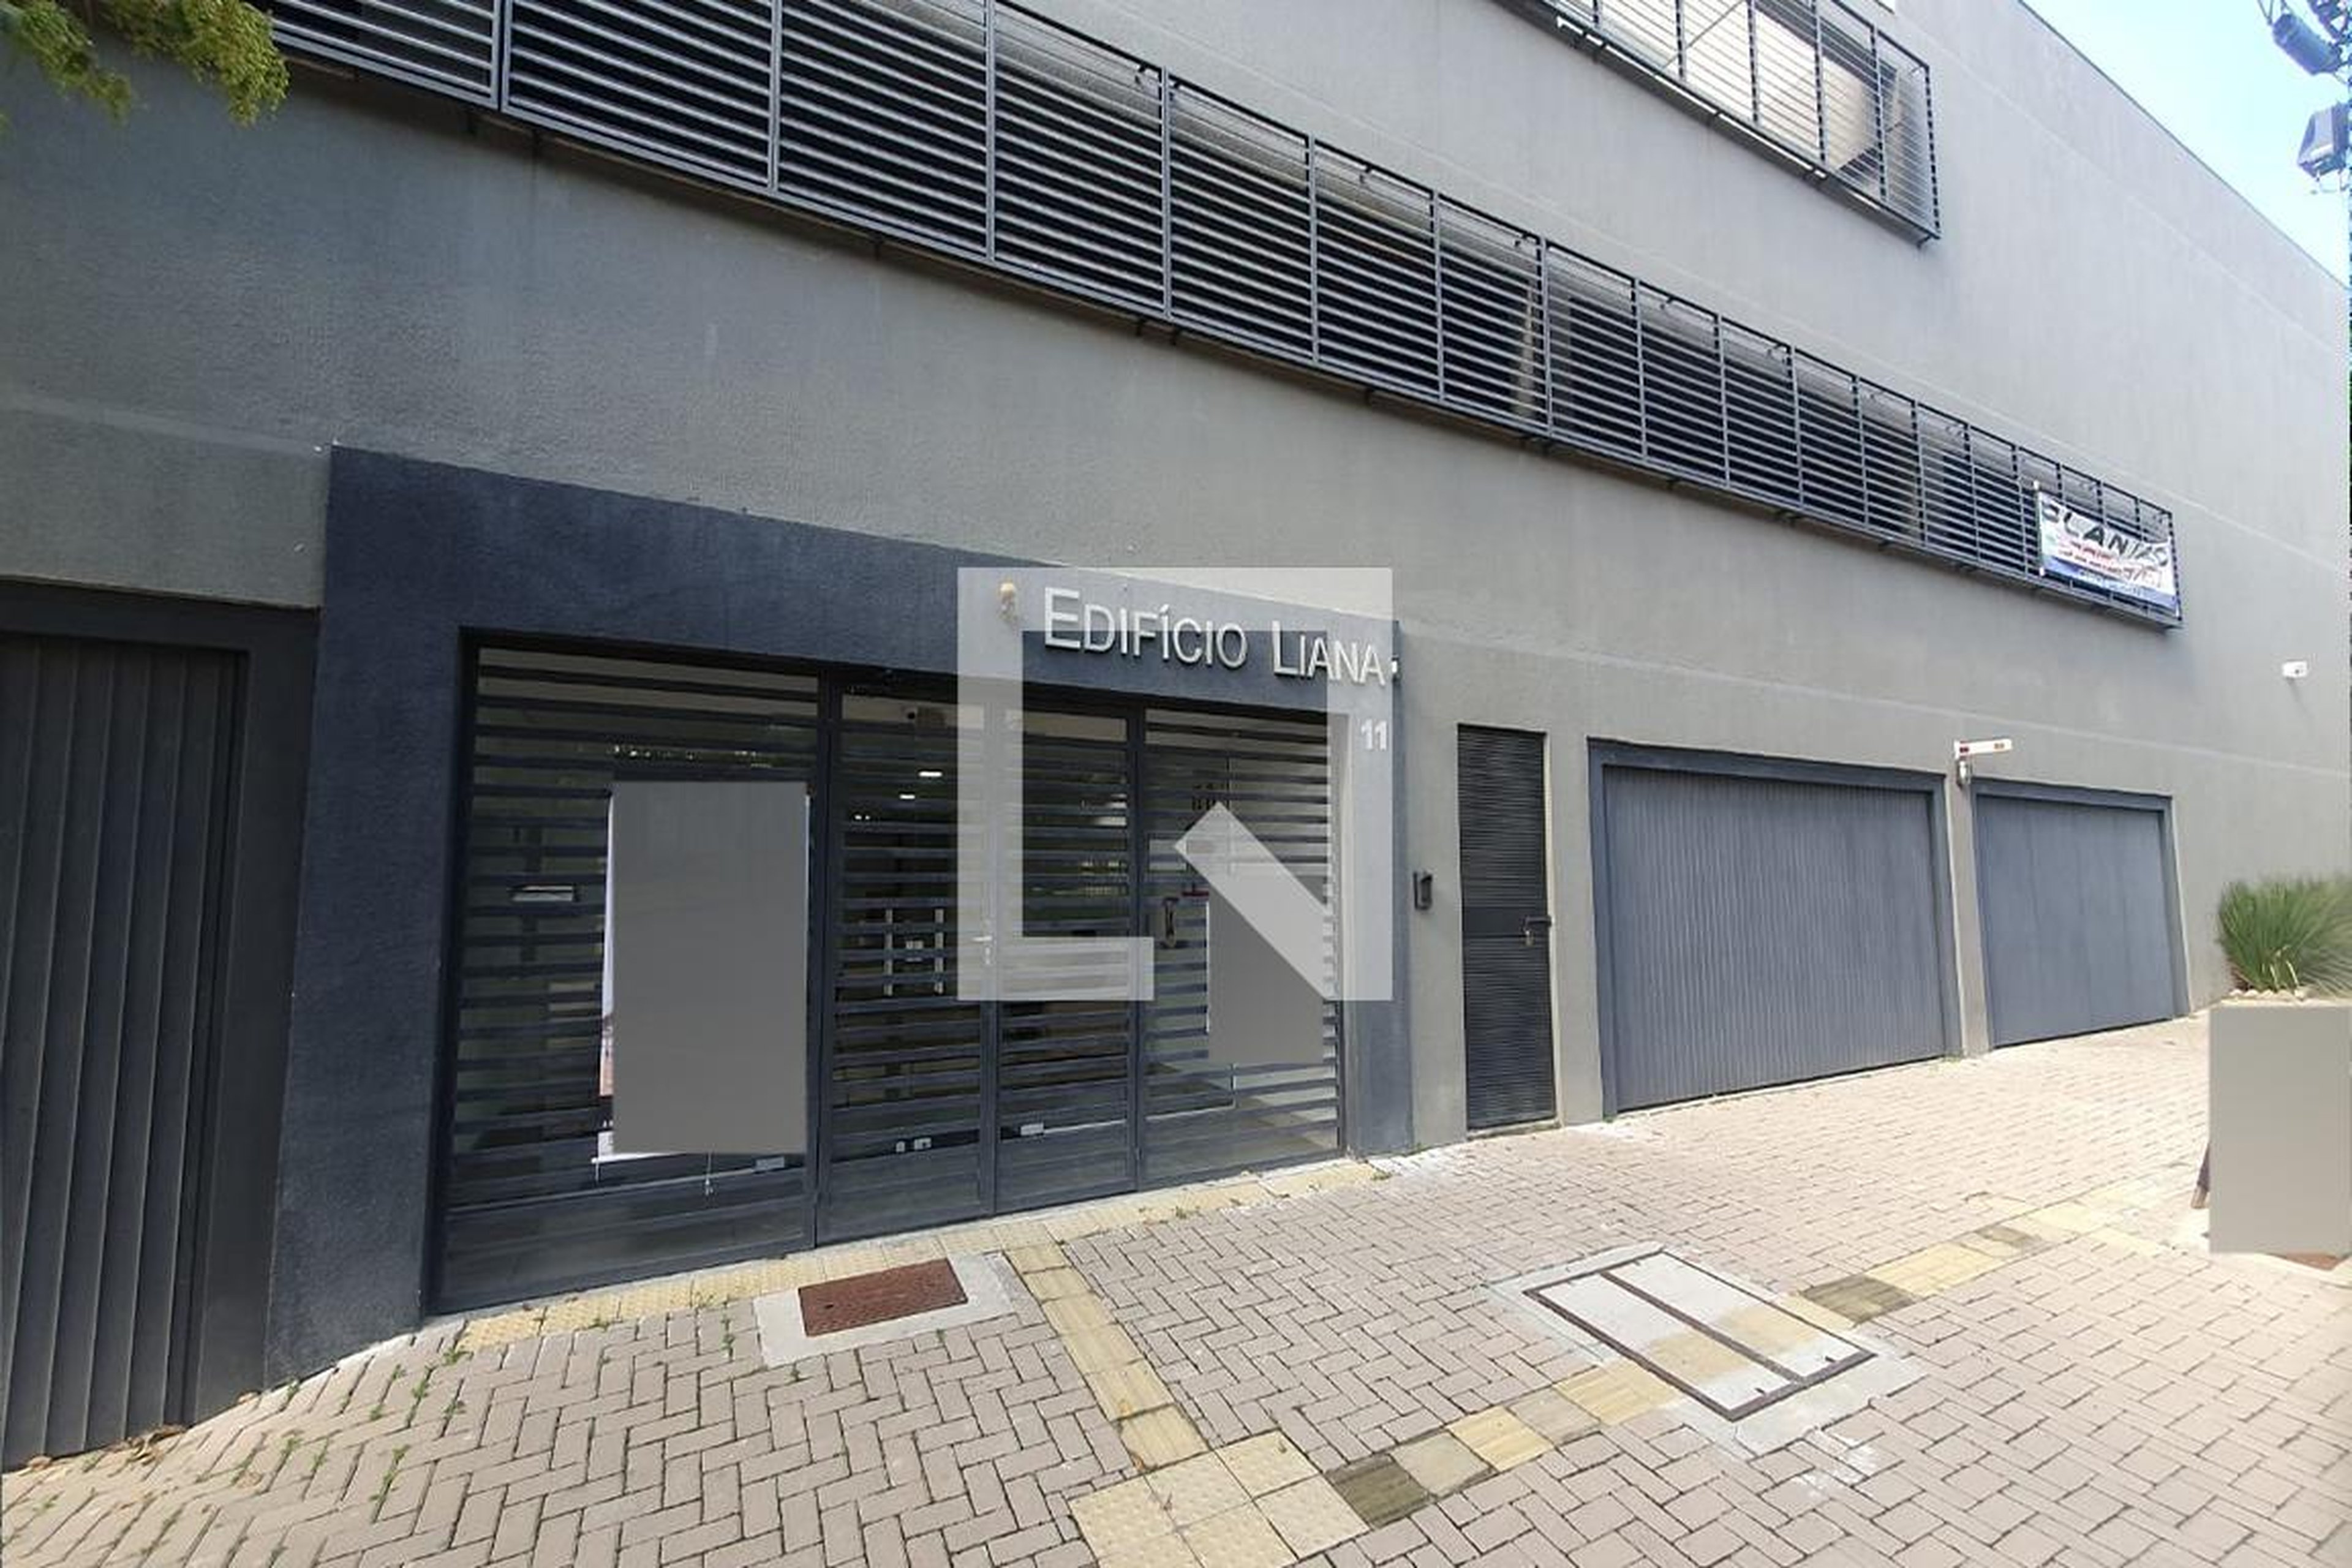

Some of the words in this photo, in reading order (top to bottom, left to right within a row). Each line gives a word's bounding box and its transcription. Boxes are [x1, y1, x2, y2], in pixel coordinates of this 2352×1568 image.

[1044, 586, 1248, 668] EDIFÍCIO
[1272, 620, 1386, 687] LIANA
[1360, 718, 1387, 751] 11
